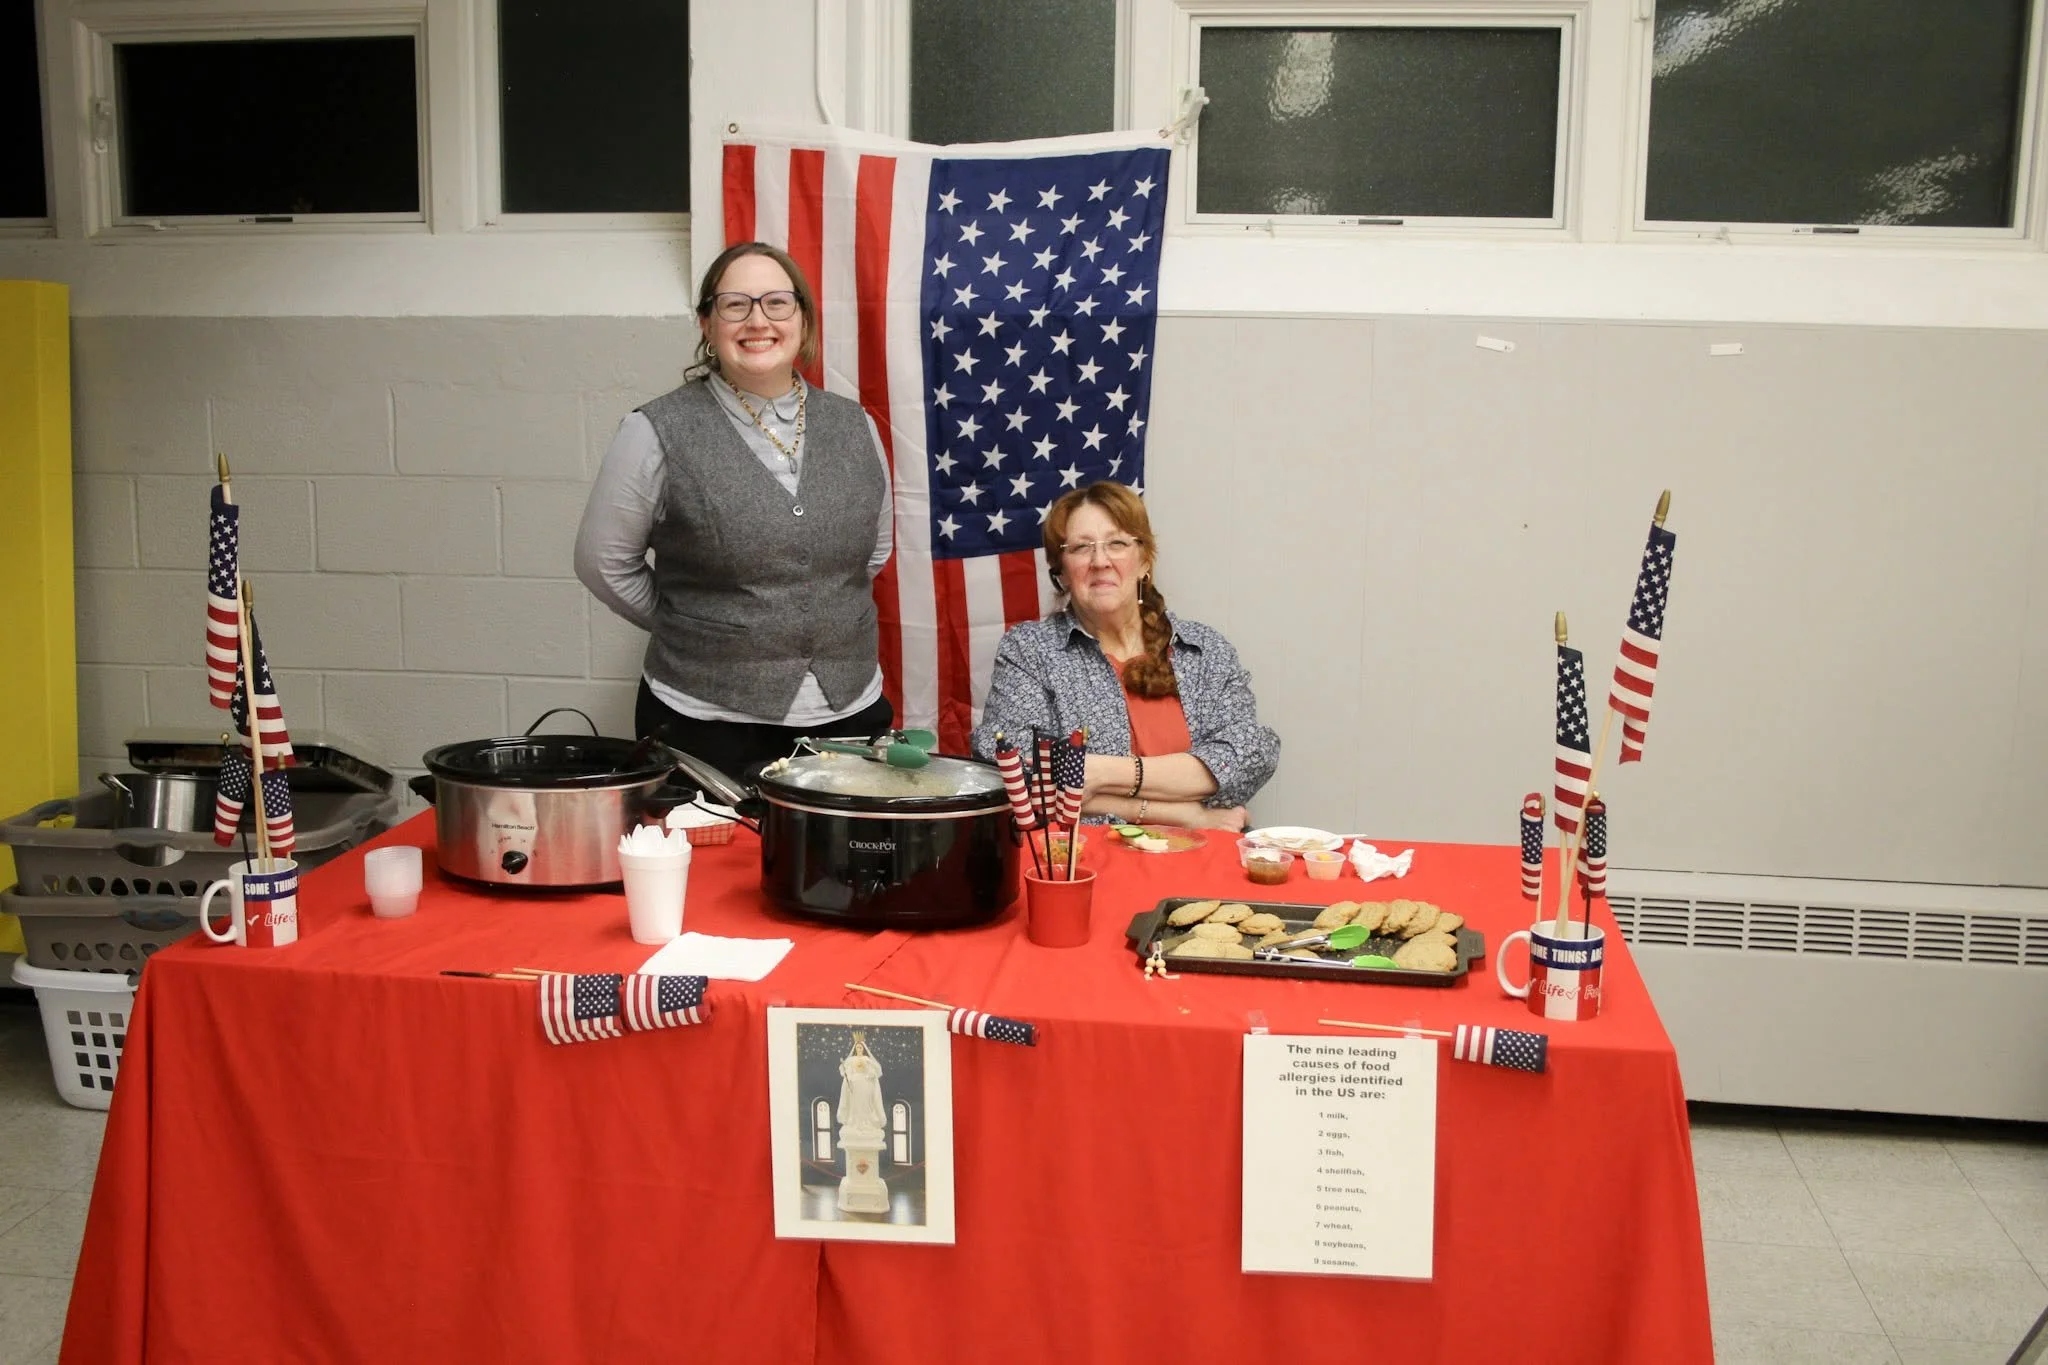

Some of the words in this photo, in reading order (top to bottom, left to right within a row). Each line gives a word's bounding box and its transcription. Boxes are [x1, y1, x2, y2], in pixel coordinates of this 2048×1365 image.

[849, 840, 896, 850] CROCK-POT
[245, 883, 269, 895] SOME
[264, 913, 288, 927] Life
[1552, 949, 1587, 963] THINGS
[1539, 980, 1564, 996] Life
[1286, 1044, 1312, 1055] The
[1315, 1045, 1345, 1056] nine
[1348, 1046, 1398, 1060] leading
[1292, 1060, 1340, 1070] causes
[1343, 1060, 1358, 1070] of
[1361, 1061, 1391, 1072] food
[1279, 1072, 1336, 1084] allergies
[1340, 1074, 1404, 1087] identified
[1295, 1086, 1308, 1097] in
[1311, 1087, 1334, 1098] the
[1337, 1088, 1356, 1099] US
[1359, 1089, 1387, 1100] are:
[1326, 1111, 1349, 1121] milk,
[1326, 1131, 1351, 1140] eggs,
[1325, 1149, 1345, 1158] fish,
[1325, 1167, 1366, 1177] shellfish,
[1324, 1186, 1343, 1194] tree
[1345, 1187, 1368, 1196] nuts,
[1323, 1204, 1363, 1213] peanuts,
[1323, 1222, 1353, 1231] wheat,
[1322, 1240, 1367, 1250] soybeans,
